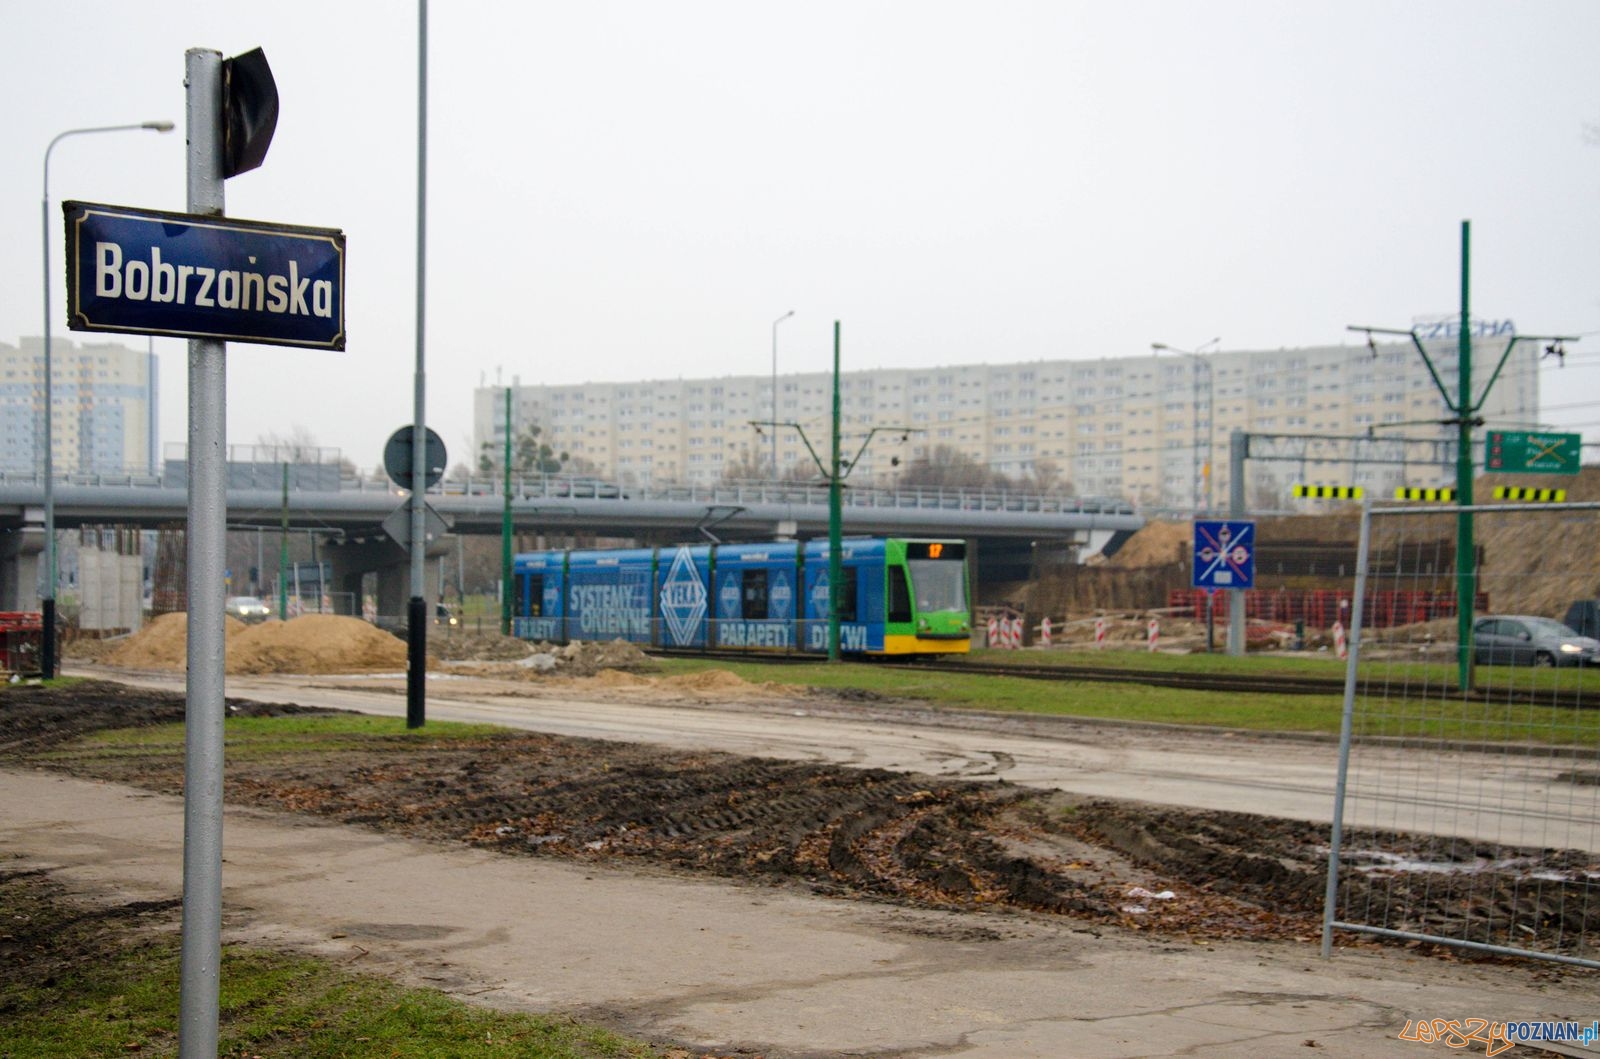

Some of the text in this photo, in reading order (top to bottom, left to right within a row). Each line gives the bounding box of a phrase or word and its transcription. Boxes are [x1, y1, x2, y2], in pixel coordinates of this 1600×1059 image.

[95, 242, 333, 319] Bobrzańska
[929, 543, 943, 559] 17
[571, 584, 634, 611] SYSTEMY
[581, 608, 649, 633] OKIENNE
[720, 623, 788, 646] PARAPETY
